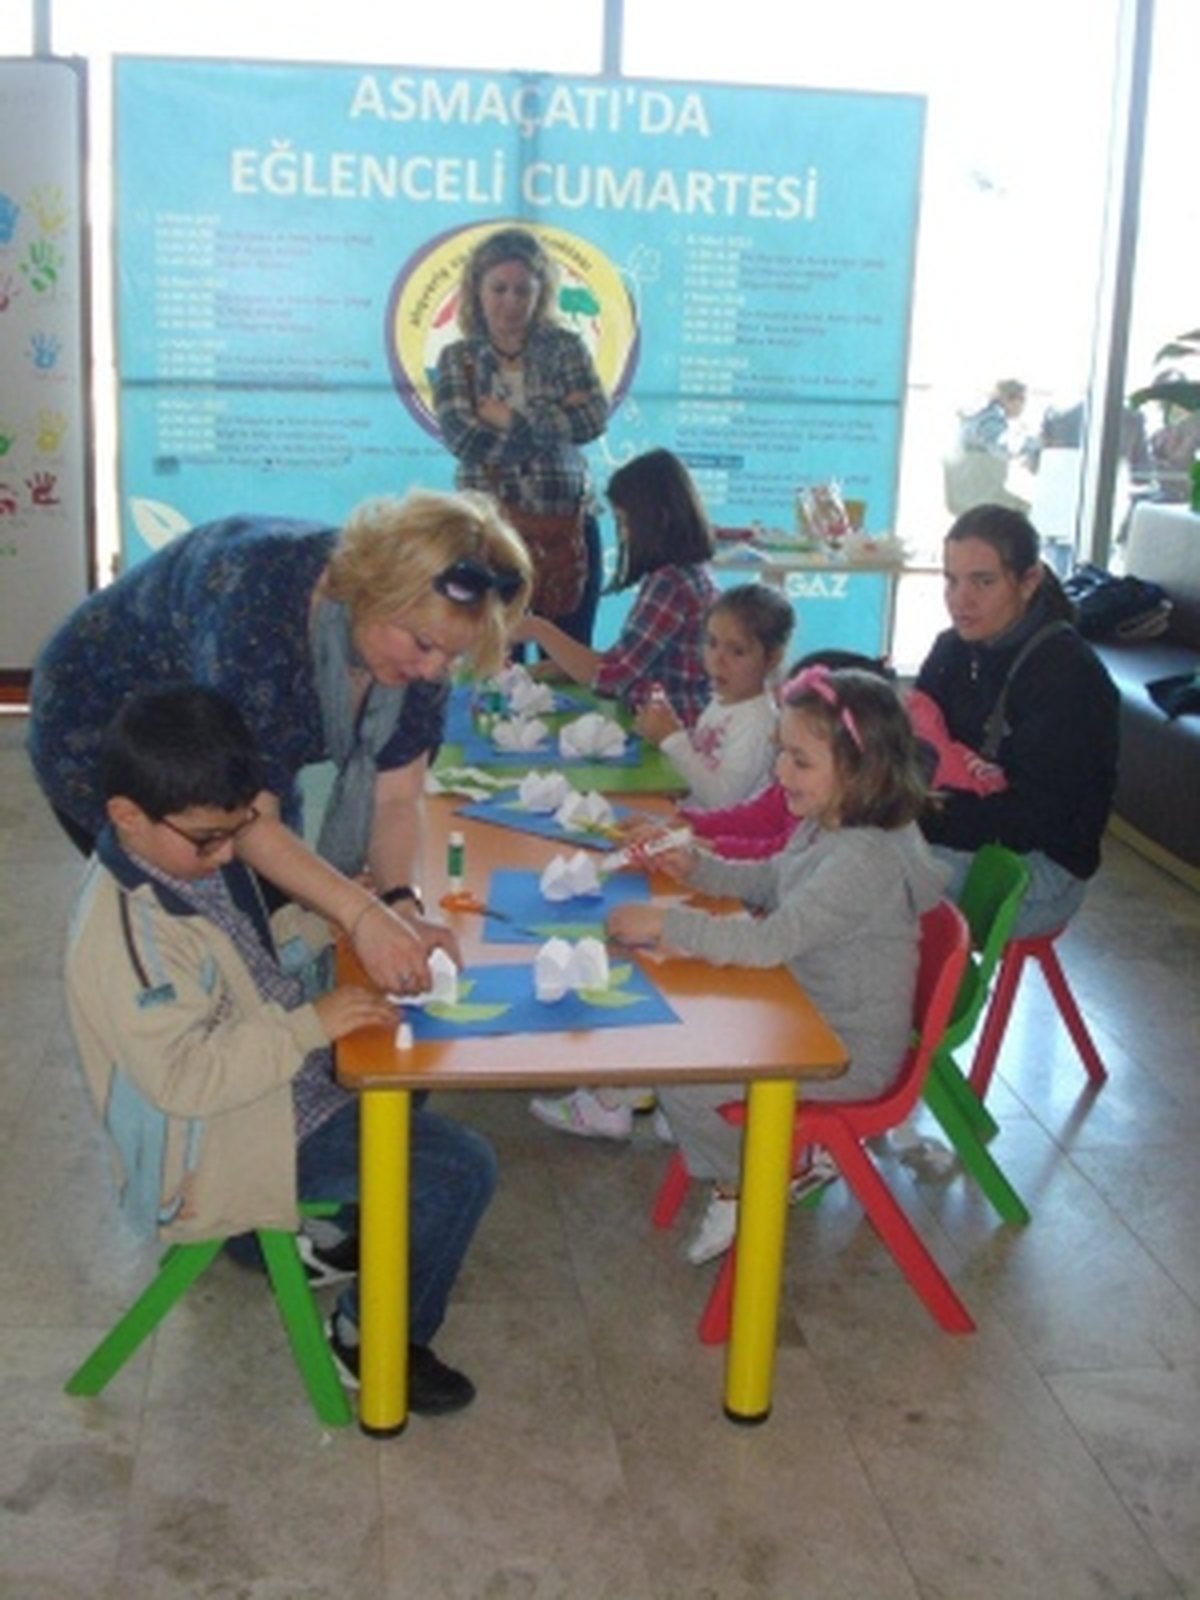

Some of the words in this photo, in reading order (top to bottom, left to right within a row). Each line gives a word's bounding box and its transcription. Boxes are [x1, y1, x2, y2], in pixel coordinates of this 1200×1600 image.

[350, 74, 711, 137] ASMAÇATI'DA
[230, 138, 505, 205] EĞLENCELİ
[520, 160, 819, 219] CUMARTESİ
